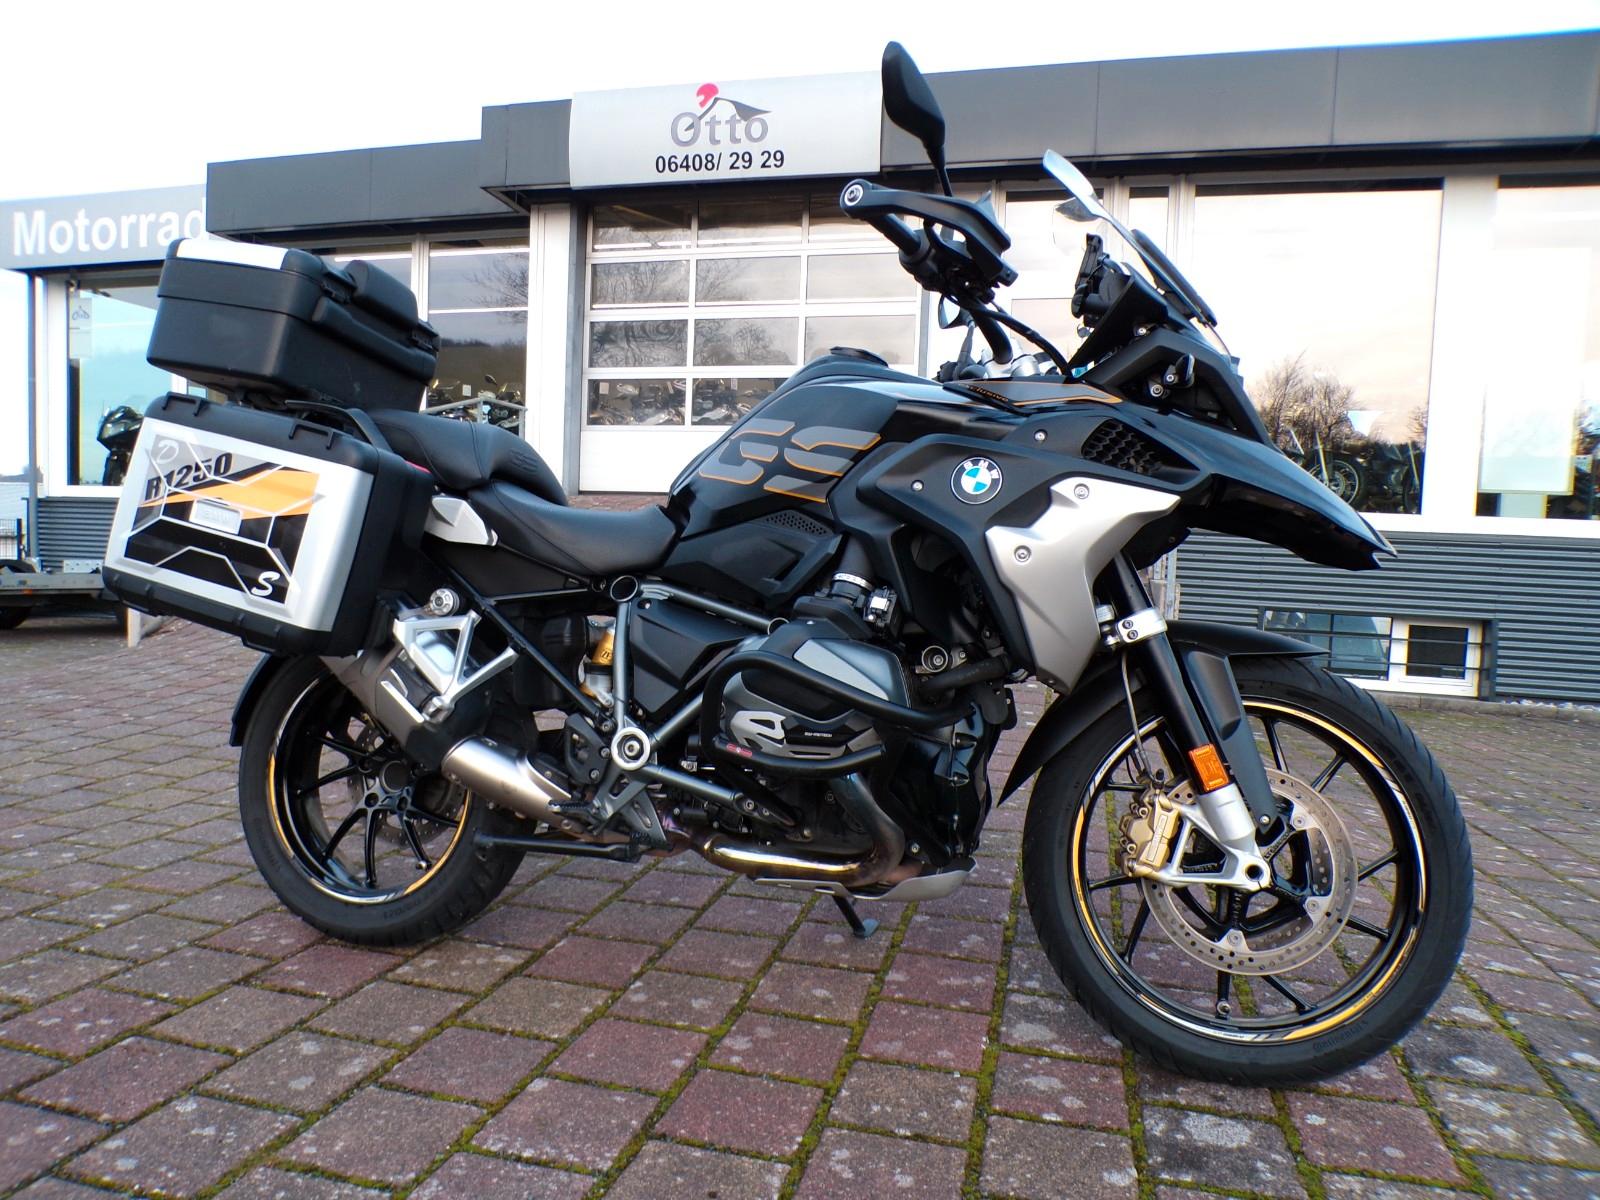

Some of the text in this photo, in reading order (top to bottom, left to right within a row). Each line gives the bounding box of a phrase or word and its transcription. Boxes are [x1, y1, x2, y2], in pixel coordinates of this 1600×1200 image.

[670, 111, 769, 147] Otto
[655, 149, 785, 173] 06408/ 29 29
[13, 198, 206, 257] Motorrad
[963, 459, 1000, 479] BMW
[250, 571, 281, 596] S
